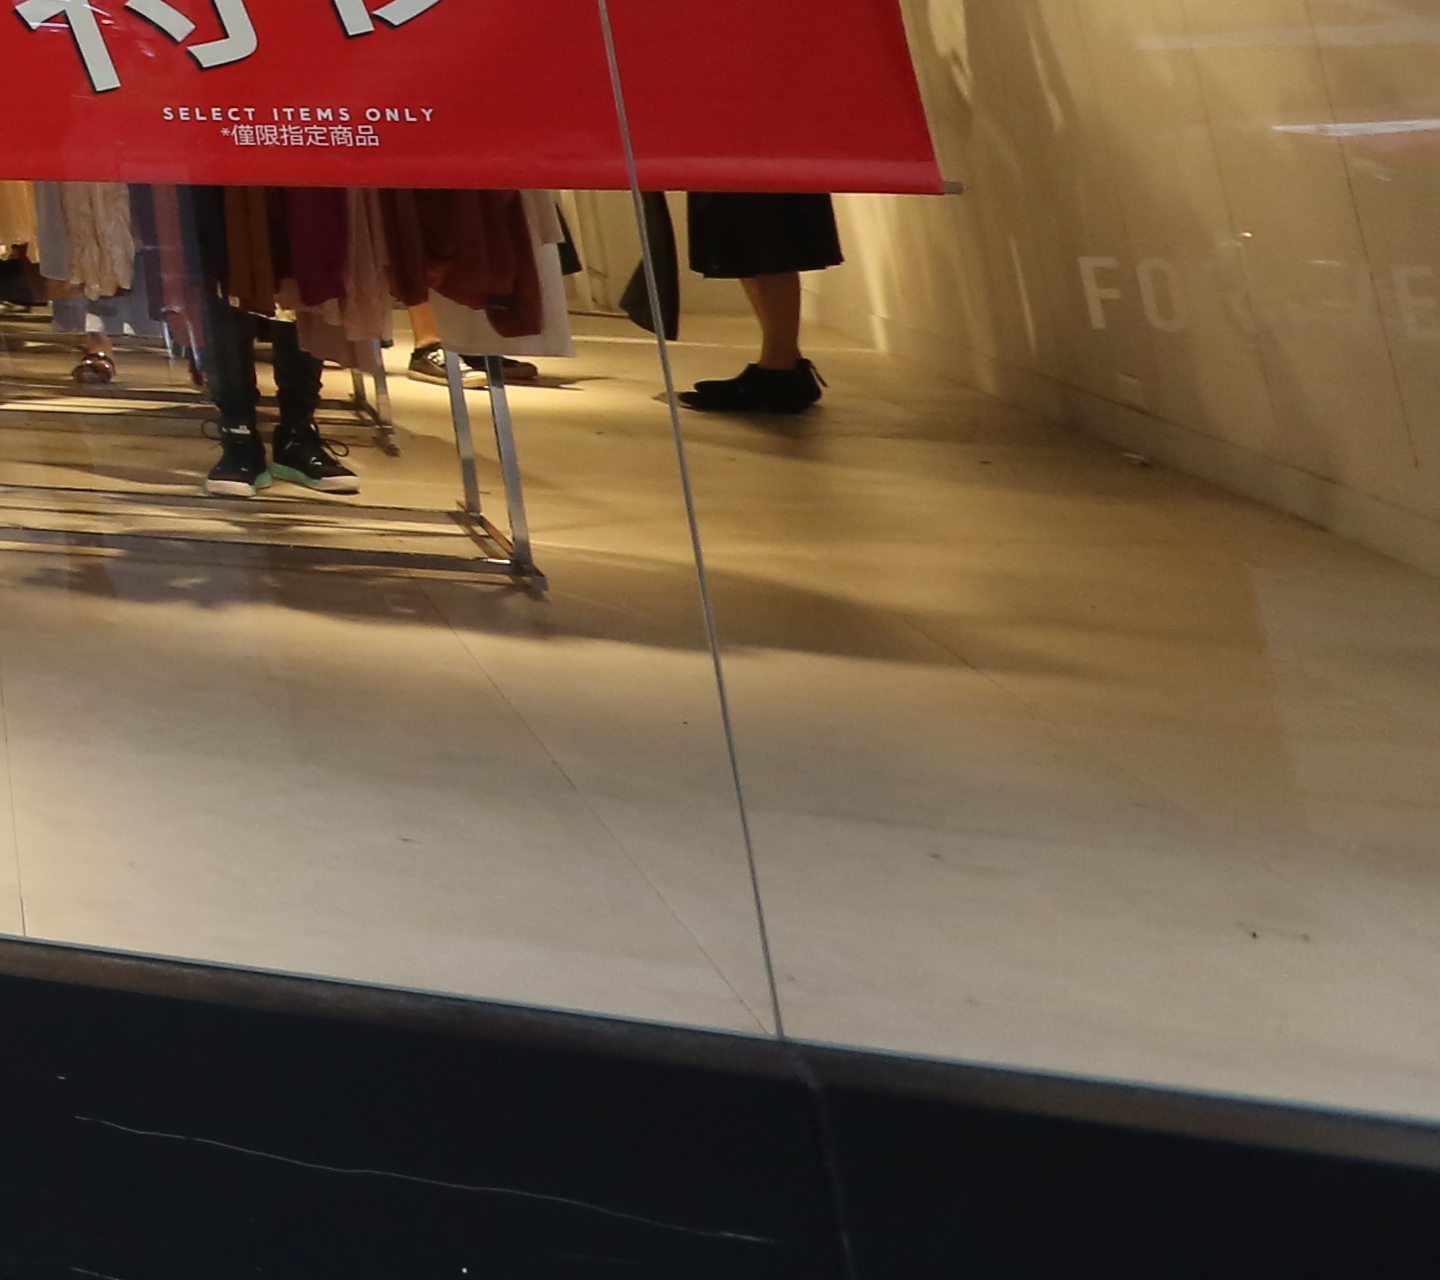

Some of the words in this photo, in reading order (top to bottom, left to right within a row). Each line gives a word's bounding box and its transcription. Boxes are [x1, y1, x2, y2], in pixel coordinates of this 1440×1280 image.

[162, 107, 256, 121] SELECT
[273, 107, 351, 121] ITEMS
[366, 107, 435, 122] ONLY
